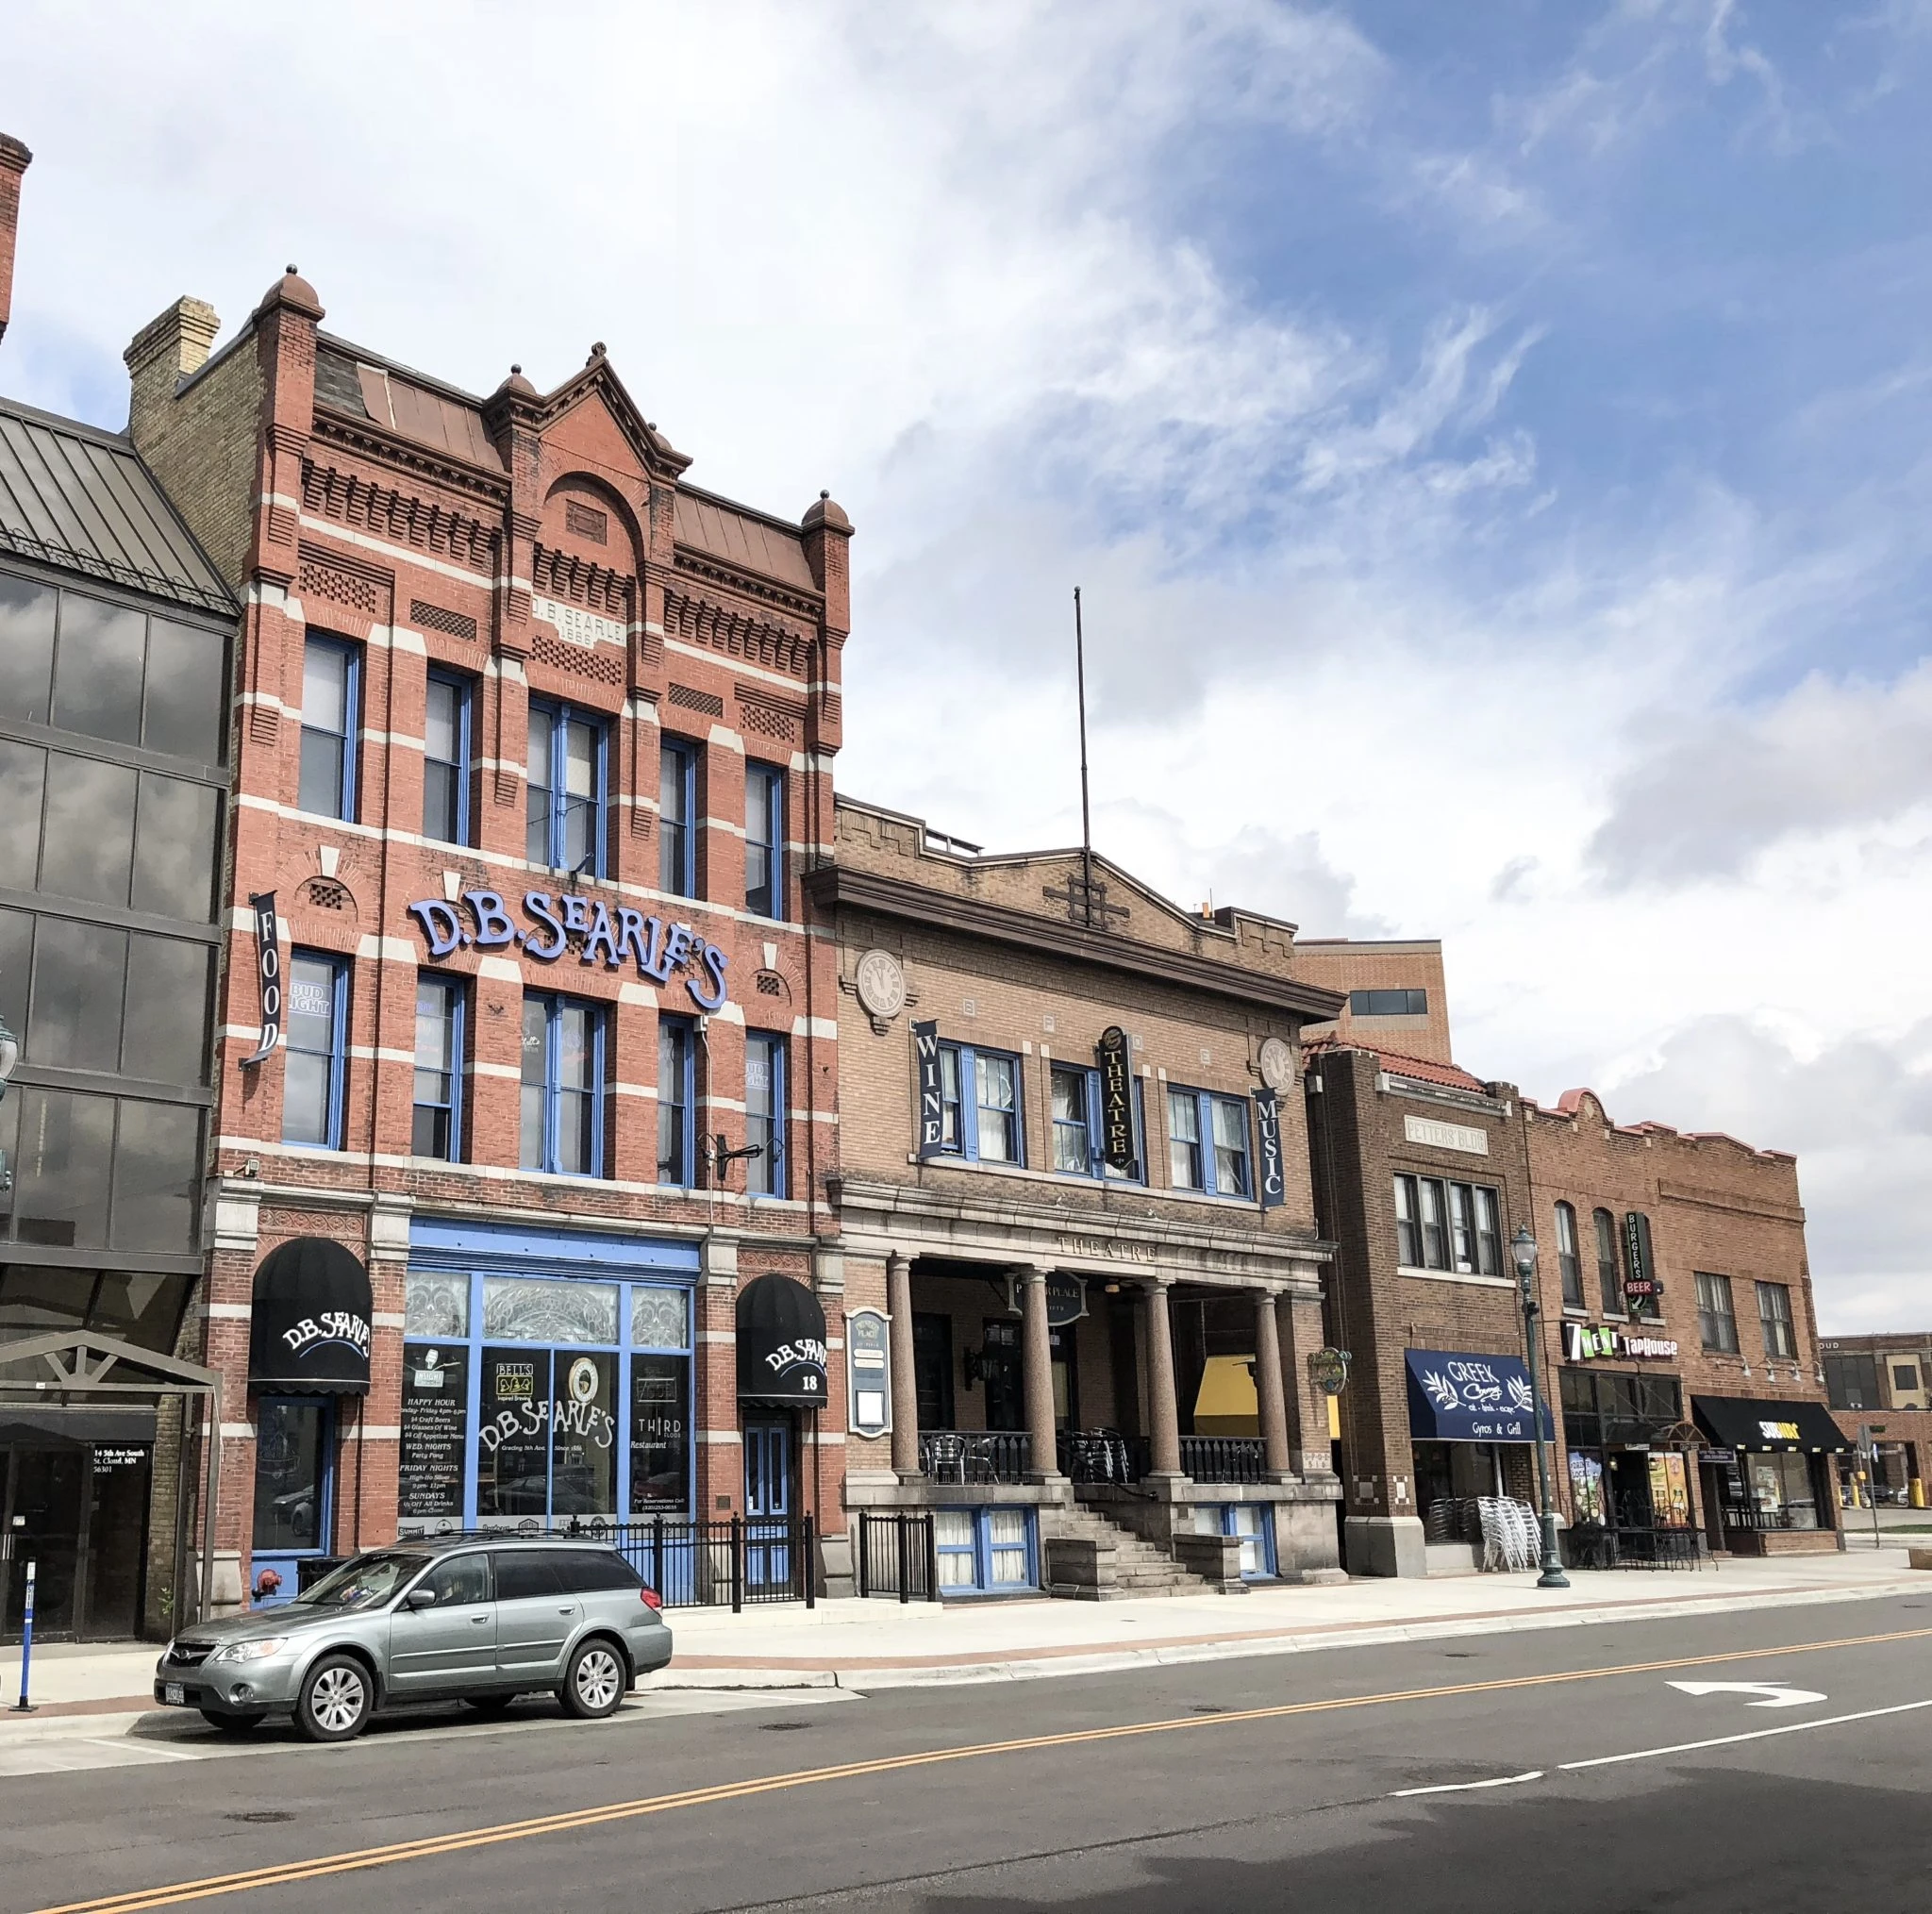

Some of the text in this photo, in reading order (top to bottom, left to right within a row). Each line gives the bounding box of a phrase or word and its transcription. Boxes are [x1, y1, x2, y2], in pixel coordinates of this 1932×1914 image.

[409, 890, 729, 1009] D.B. SEARLE'S
[258, 911, 280, 1052] FOOD
[291, 983, 324, 1000] BUD
[746, 1062, 765, 1075] UD
[916, 1034, 941, 1144] WINE
[1105, 1050, 1127, 1154] THEATRE
[1257, 1100, 1281, 1194] MUSIC
[1058, 1237, 1157, 1262] THEATRE
[1628, 1214, 1641, 1279] BURGERS
[1626, 1282, 1652, 1293] BEER
[1566, 1323, 1582, 1360] 7
[1581, 1331, 1619, 1354] WEST
[1818, 1341, 1840, 1350] OUD
[498, 1365, 531, 1375] BELL'S
[1447, 1361, 1500, 1383] GREEK
[802, 1375, 818, 1390] 18
[400, 1406, 419, 1415] onday-
[522, 1400, 615, 1448] SEARLE'S
[638, 1416, 681, 1436] THIRD
[1472, 1422, 1521, 1438] Gyros & Grill
[425, 1442, 452, 1451] NIGHTS
[631, 1440, 667, 1449] Restaurant
[95, 1449, 144, 1457] 14 5th Ave South
[124, 1456, 137, 1465] MN
[93, 1465, 112, 1473] 56301
[398, 1527, 425, 1538] SUMMIT
